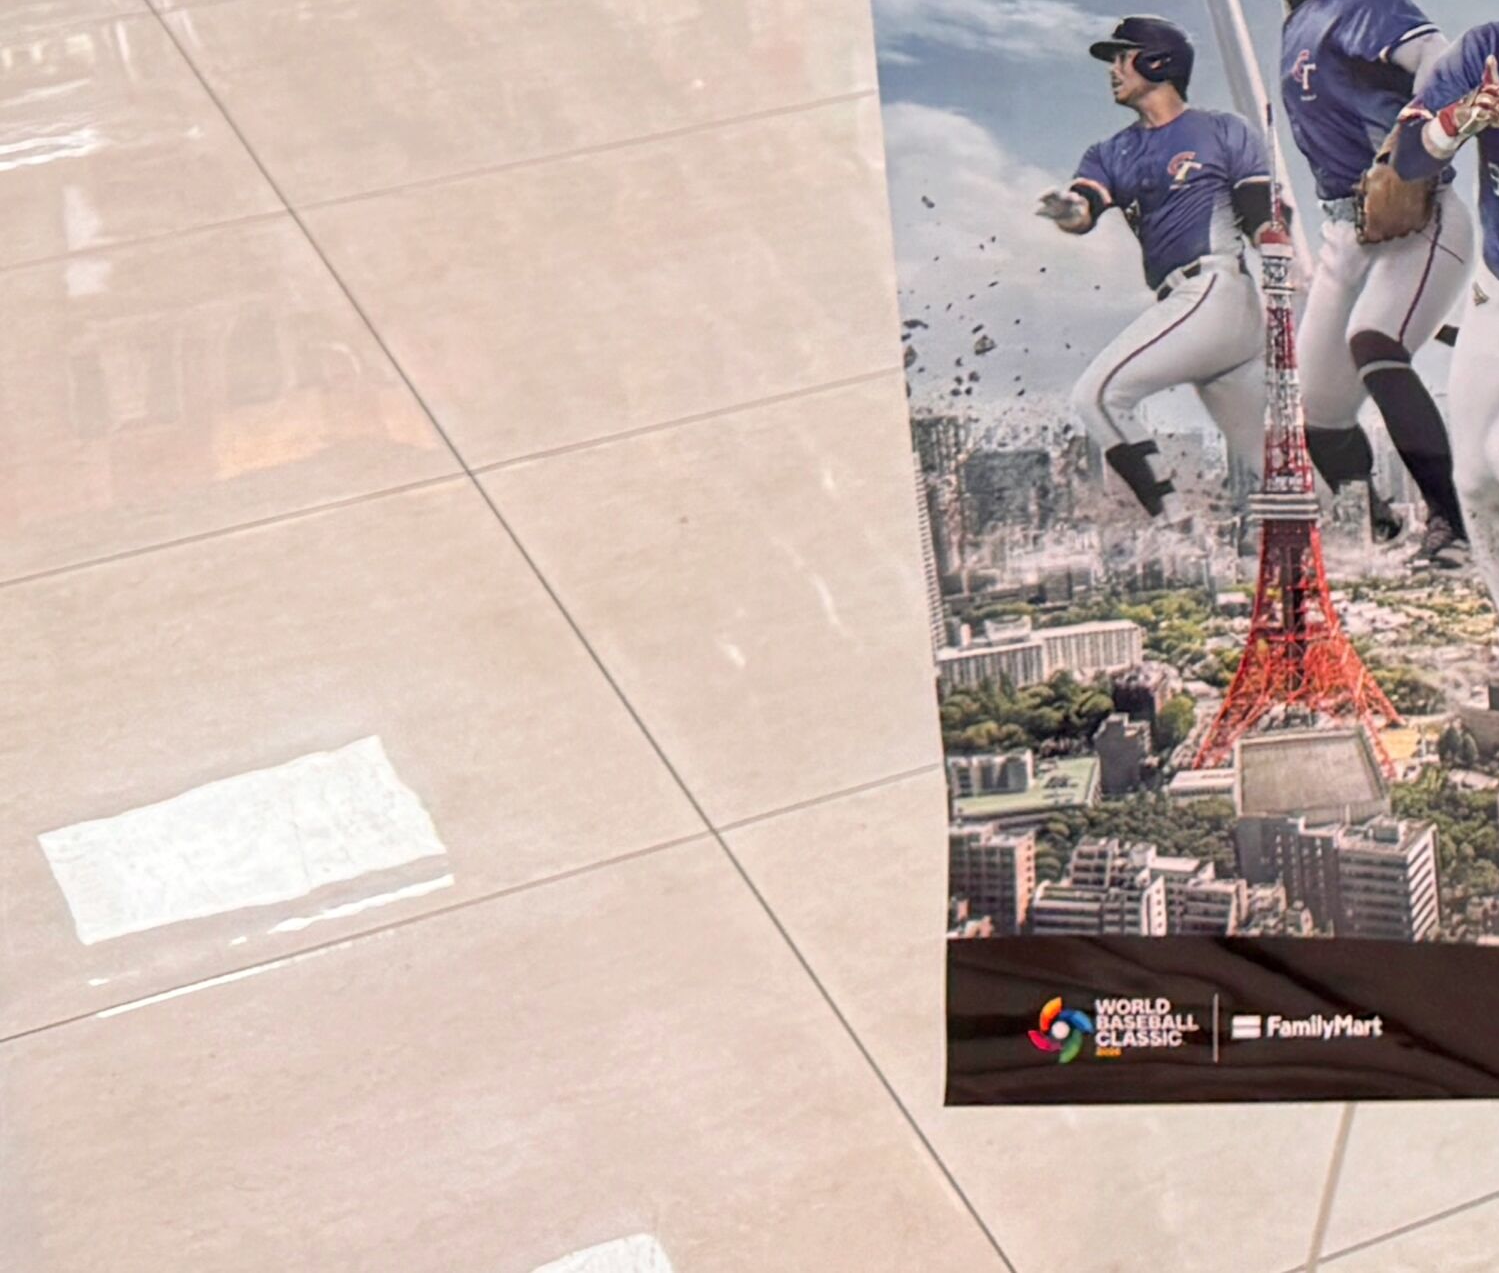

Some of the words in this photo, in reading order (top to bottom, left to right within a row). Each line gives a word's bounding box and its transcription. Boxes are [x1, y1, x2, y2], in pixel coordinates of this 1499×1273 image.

[1095, 999, 1171, 1015] WORLD
[1095, 1015, 1199, 1031] BASEBALL
[1266, 1015, 1383, 1041] FamilyMart
[1095, 1031, 1184, 1047] CLASSIC
